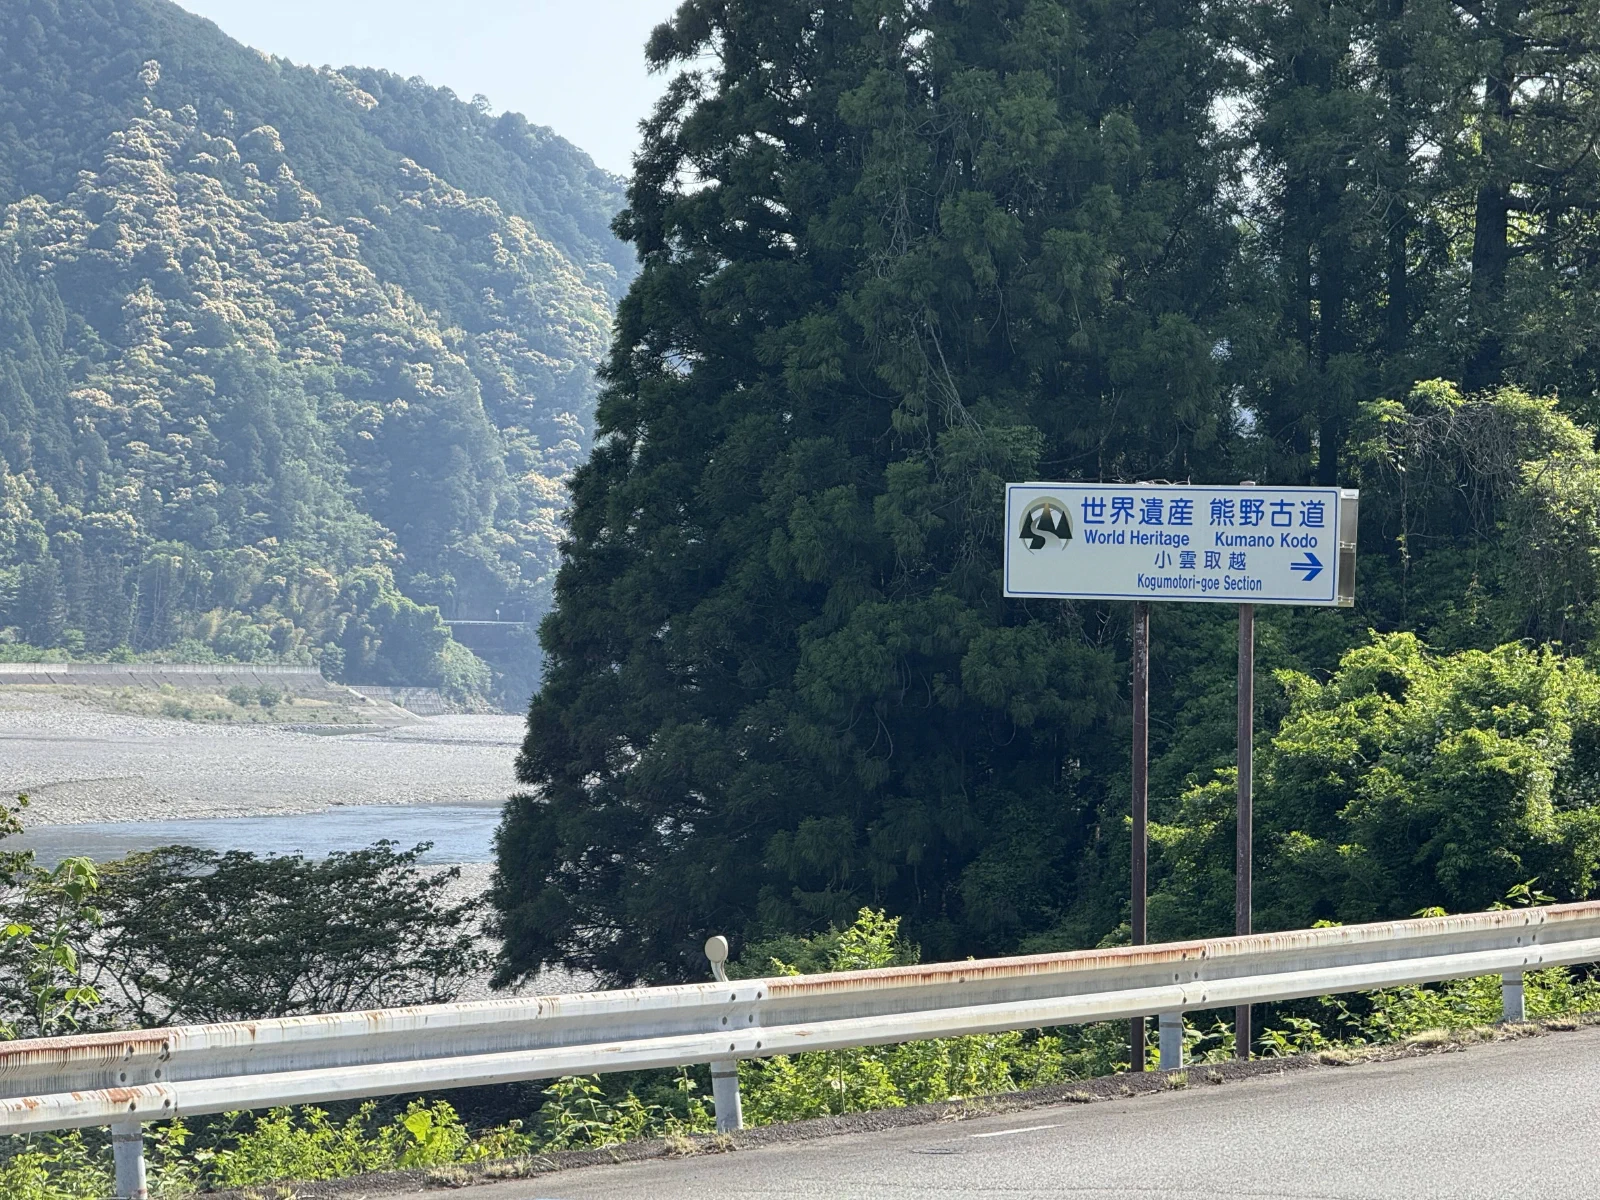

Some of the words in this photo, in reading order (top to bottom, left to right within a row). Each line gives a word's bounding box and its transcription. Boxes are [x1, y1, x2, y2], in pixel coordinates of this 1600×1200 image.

[1081, 496, 1194, 526] 世界遺産
[1209, 498, 1326, 528] 熊野古道
[1084, 529, 1125, 545] World
[1130, 530, 1190, 548] Heritage
[1215, 531, 1275, 548] Kumano
[1280, 532, 1318, 548] Kodo
[1154, 550, 1247, 571] 小雲取越
[1137, 573, 1220, 592] Kogumotori-goe
[1223, 575, 1262, 591] Section
